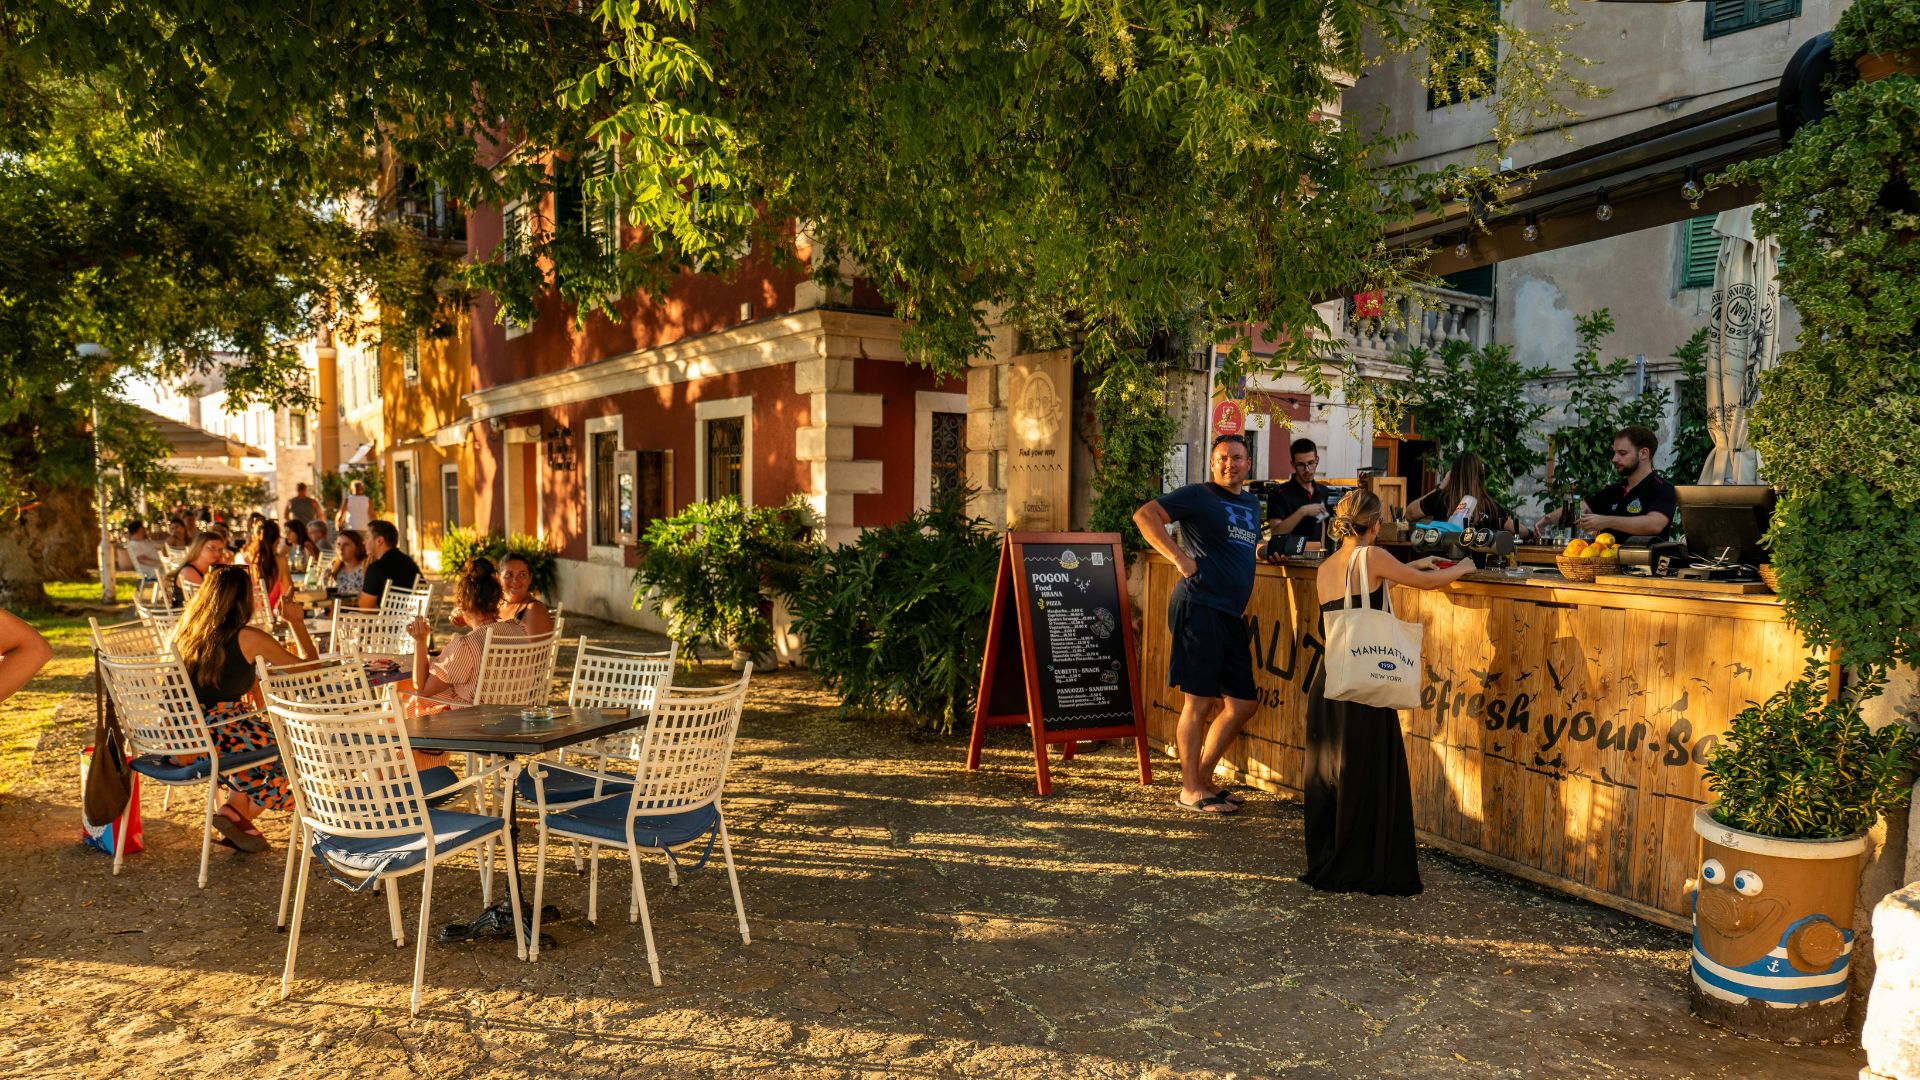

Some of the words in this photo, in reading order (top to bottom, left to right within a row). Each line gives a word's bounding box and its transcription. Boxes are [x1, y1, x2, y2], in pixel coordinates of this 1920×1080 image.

[1031, 449, 1043, 458] your
[1228, 525, 1257, 540] UNDER
[1032, 573, 1070, 583] POGON
[1035, 584, 1052, 592] Food
[1351, 645, 1414, 667] MANHATTAN
[1421, 679, 1530, 734] efresh
